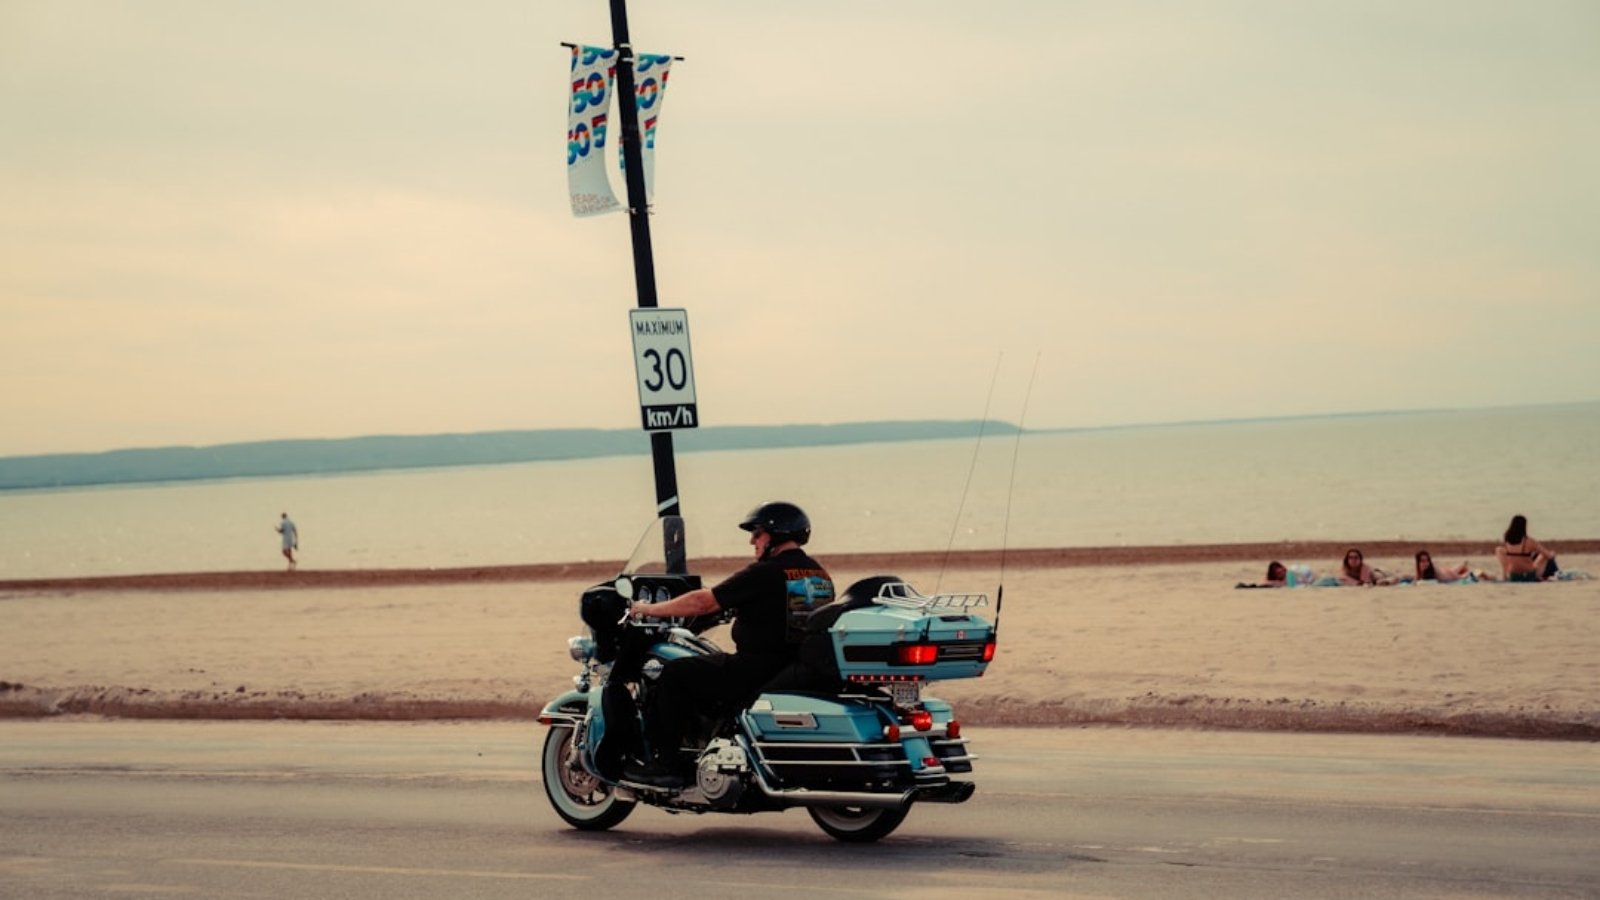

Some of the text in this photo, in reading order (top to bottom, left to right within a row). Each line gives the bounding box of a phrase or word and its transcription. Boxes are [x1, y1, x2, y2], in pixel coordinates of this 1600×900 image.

[573, 72, 605, 113] 50
[636, 321, 684, 335] MAXIMUM
[643, 347, 687, 392] 30
[646, 406, 693, 426] km/h
